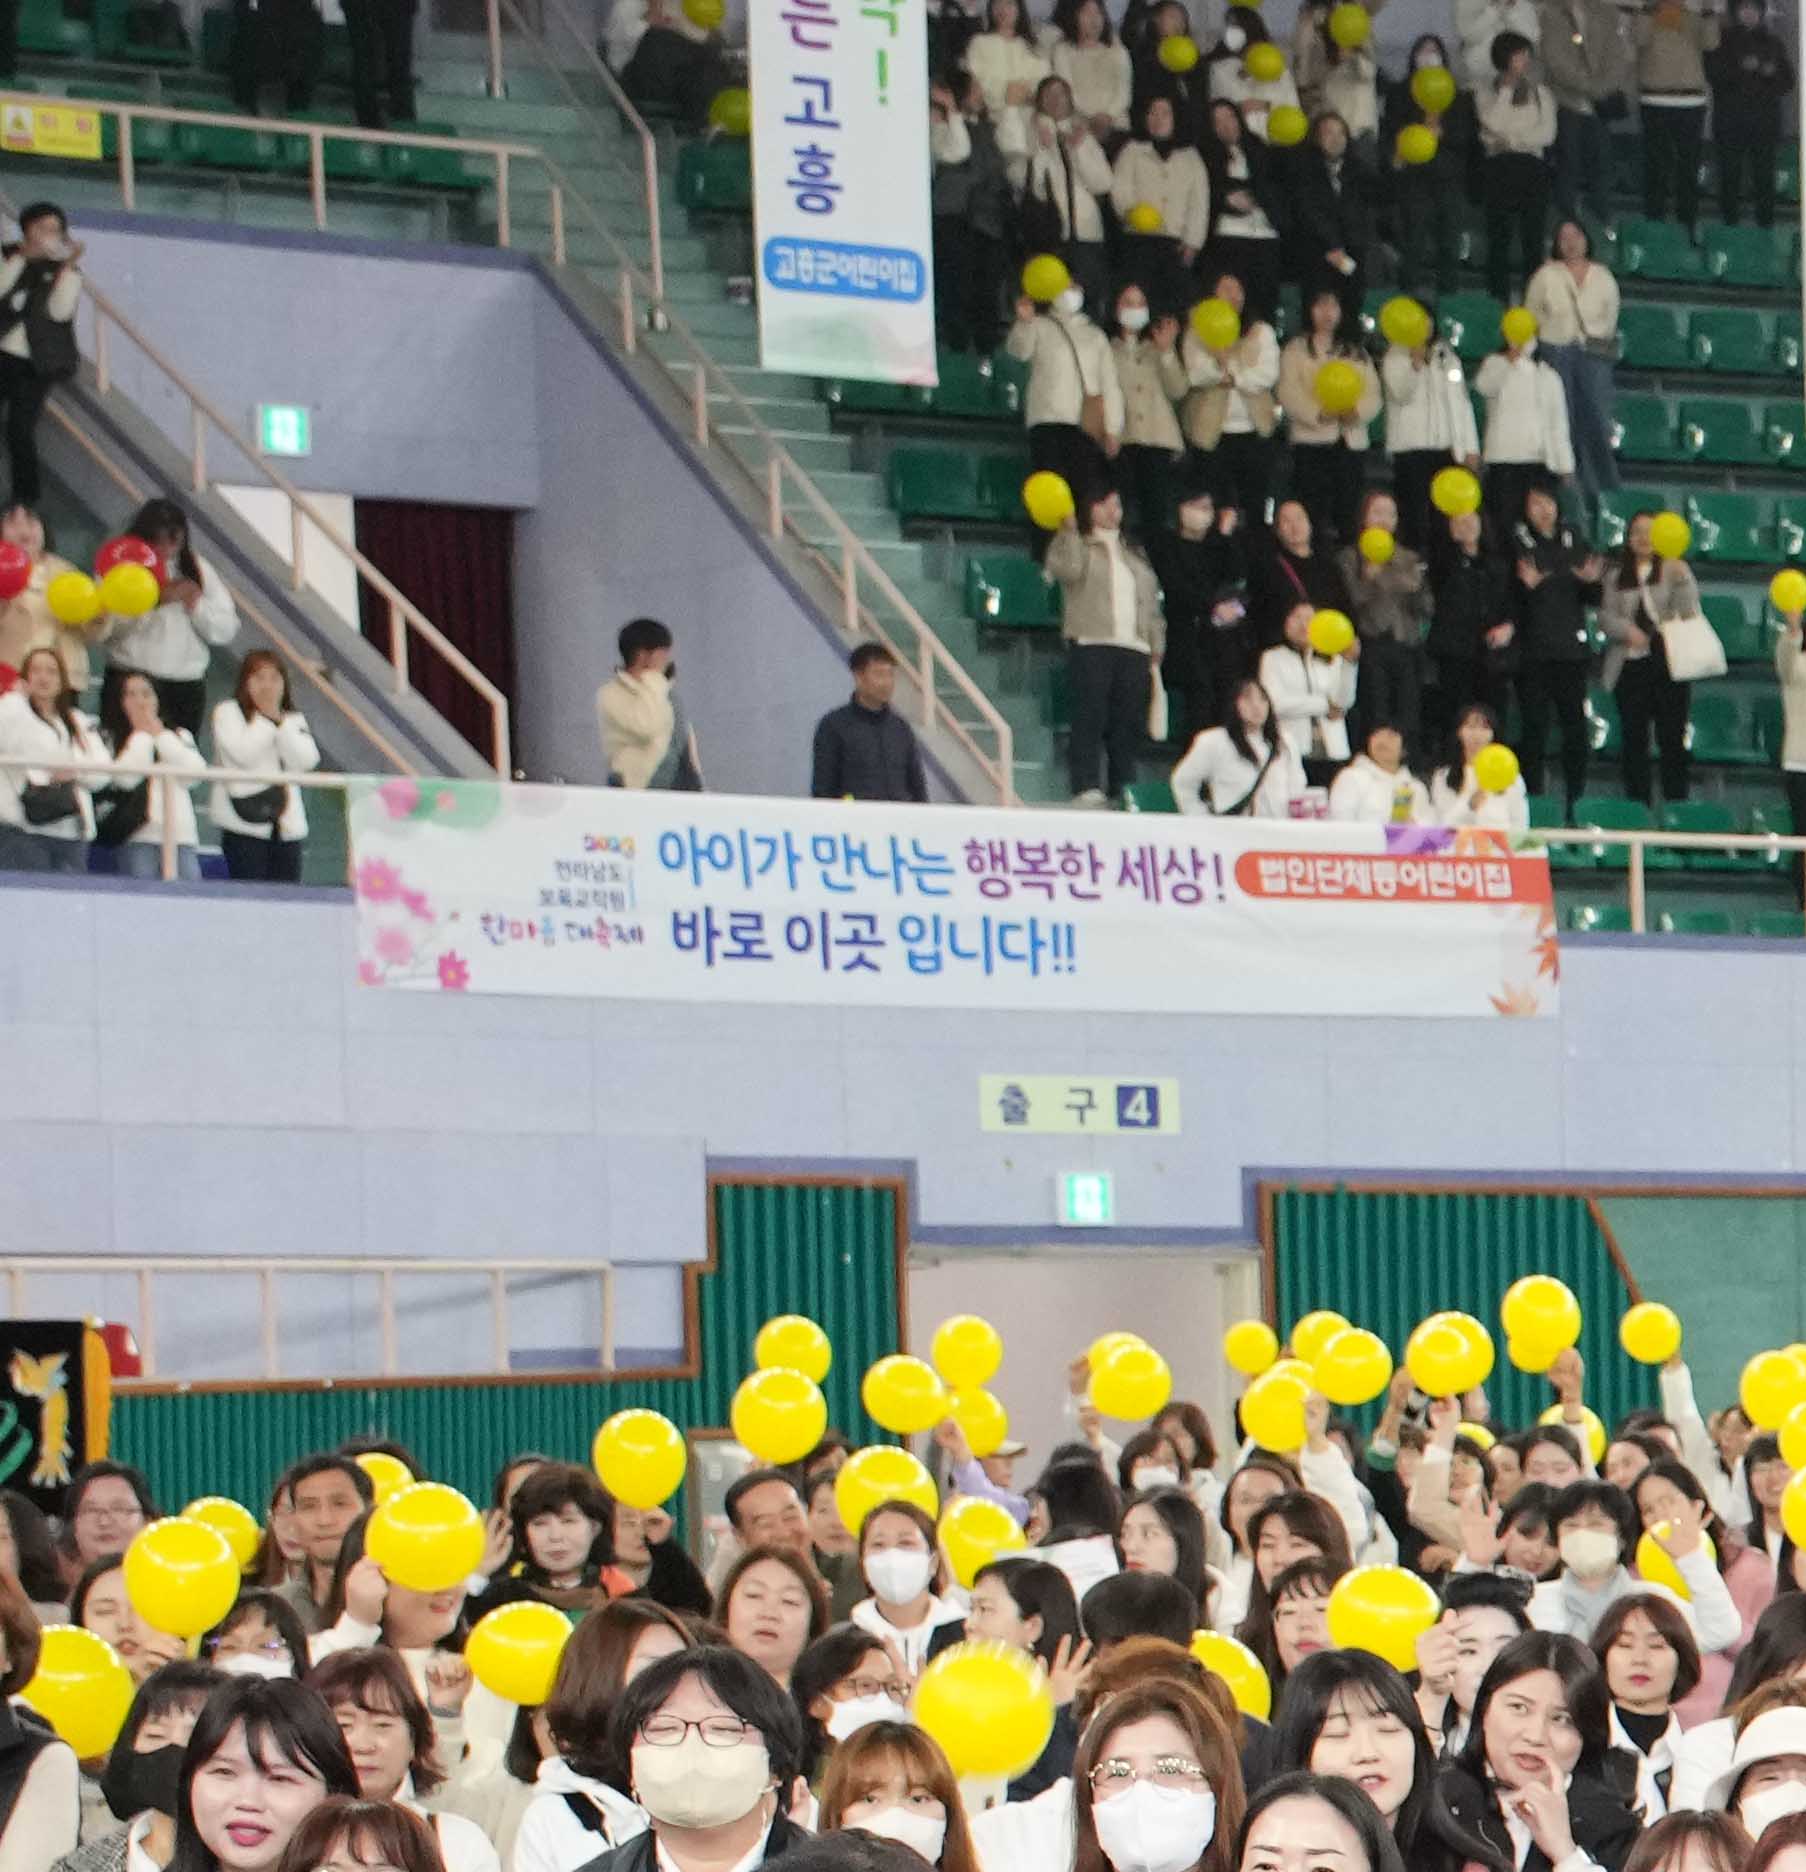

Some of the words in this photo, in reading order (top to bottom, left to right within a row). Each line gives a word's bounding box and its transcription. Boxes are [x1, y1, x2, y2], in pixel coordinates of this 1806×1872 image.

[783, 74, 843, 215] 고흥
[658, 826, 802, 893] 아이가
[812, 833, 956, 896] 만나는
[964, 839, 1103, 901] 행복한
[1117, 844, 1225, 905] 세상!
[671, 908, 773, 968] 바로
[785, 911, 885, 973] 이곳
[899, 914, 1078, 977] 입니다!!
[1121, 1087, 1154, 1126] 4
